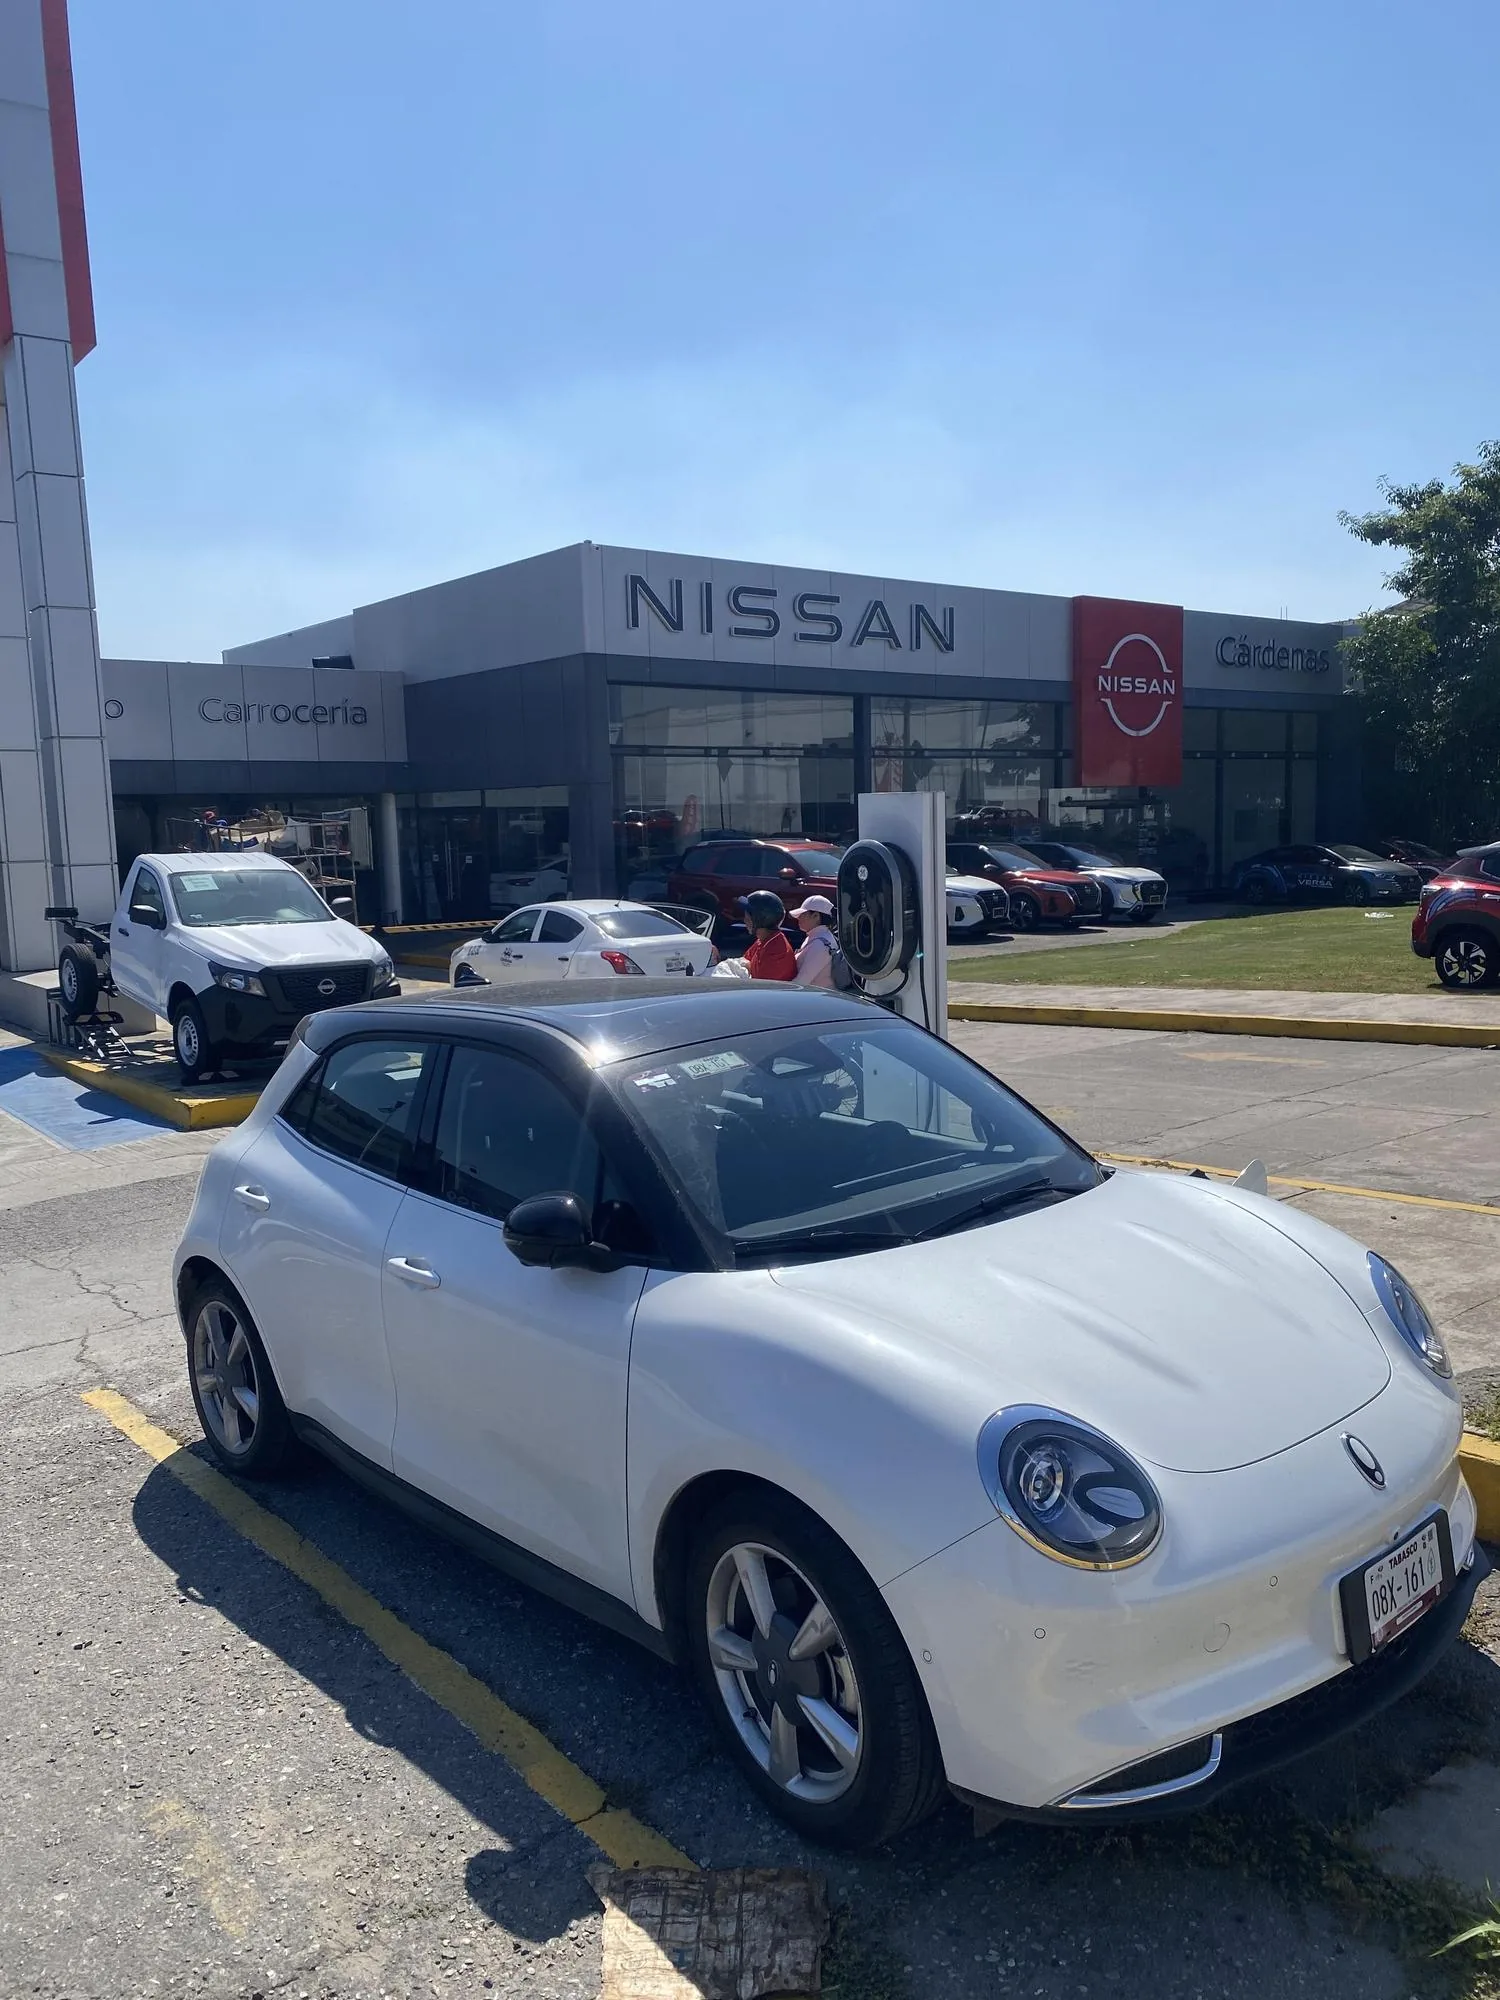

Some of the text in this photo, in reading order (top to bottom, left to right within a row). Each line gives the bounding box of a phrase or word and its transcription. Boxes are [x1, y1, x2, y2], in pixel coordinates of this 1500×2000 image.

[626, 574, 955, 652] NISSAN
[1216, 636, 1329, 673] Cárdenas
[1098, 675, 1176, 694] NISSAN
[200, 698, 367, 724] Carrocería
[1388, 1541, 1418, 1570] TABASCO
[1372, 1556, 1425, 1621] 08X-161
